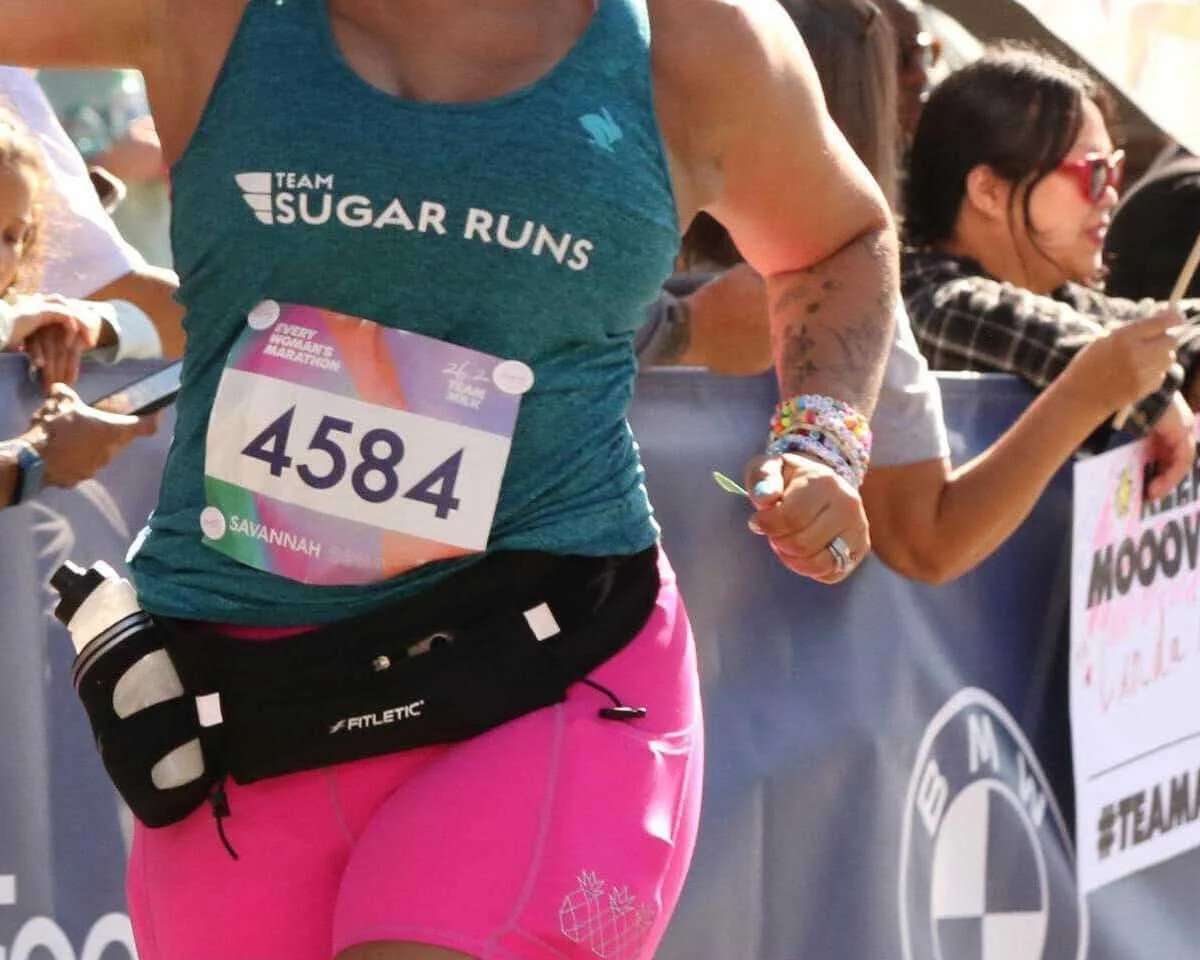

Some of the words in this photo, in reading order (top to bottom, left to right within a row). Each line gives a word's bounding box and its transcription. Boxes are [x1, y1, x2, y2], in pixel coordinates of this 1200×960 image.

[275, 172, 334, 190] TEAM
[275, 191, 447, 236] SUGAR
[462, 207, 595, 272] RUNS
[268, 333, 335, 358] WOMAN'S
[273, 321, 319, 341] EVERY
[263, 344, 342, 373] MARATHON
[240, 404, 464, 520] 4584
[228, 515, 323, 558] SAVANNAH
[347, 699, 425, 731] FITLETIC
